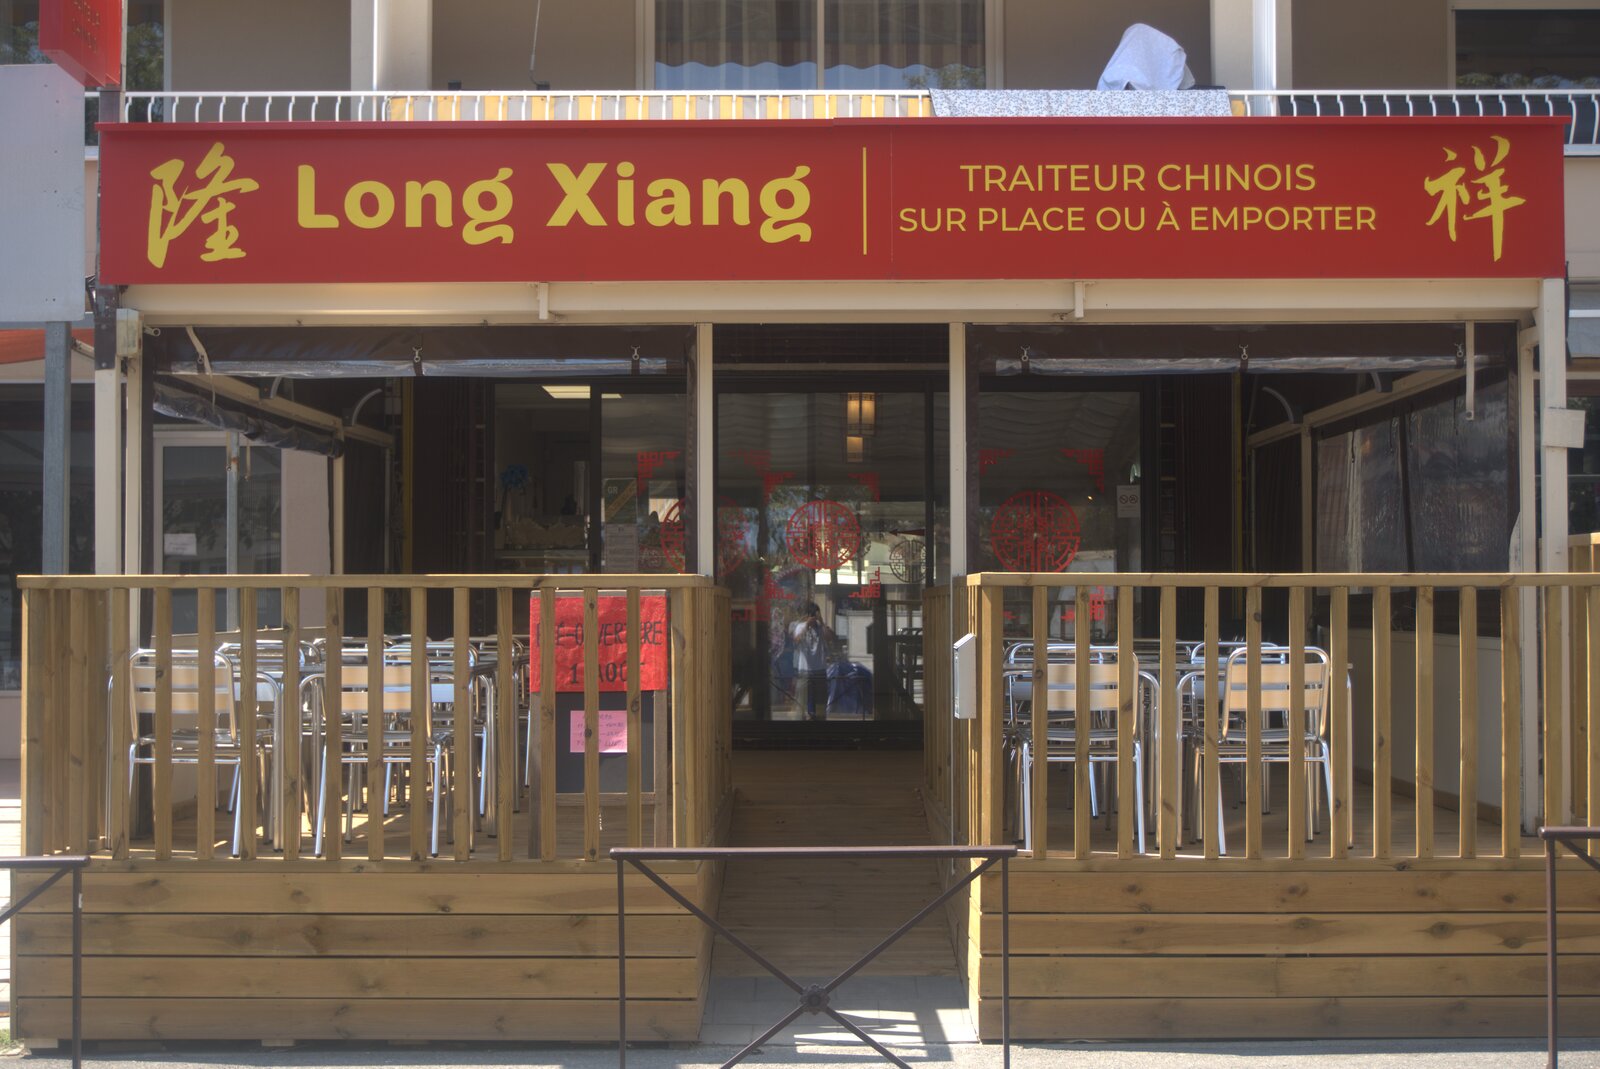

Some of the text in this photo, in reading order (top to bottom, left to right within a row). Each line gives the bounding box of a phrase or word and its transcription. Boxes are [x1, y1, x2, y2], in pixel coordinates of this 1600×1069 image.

[147, 142, 260, 268] 隆
[297, 161, 813, 245] Long Xiang
[898, 200, 1377, 233] SUR PLACE OU À EMPORTER
[960, 163, 1317, 193] TRAITEUR CHINOIS
[1424, 135, 1526, 262] 祥
